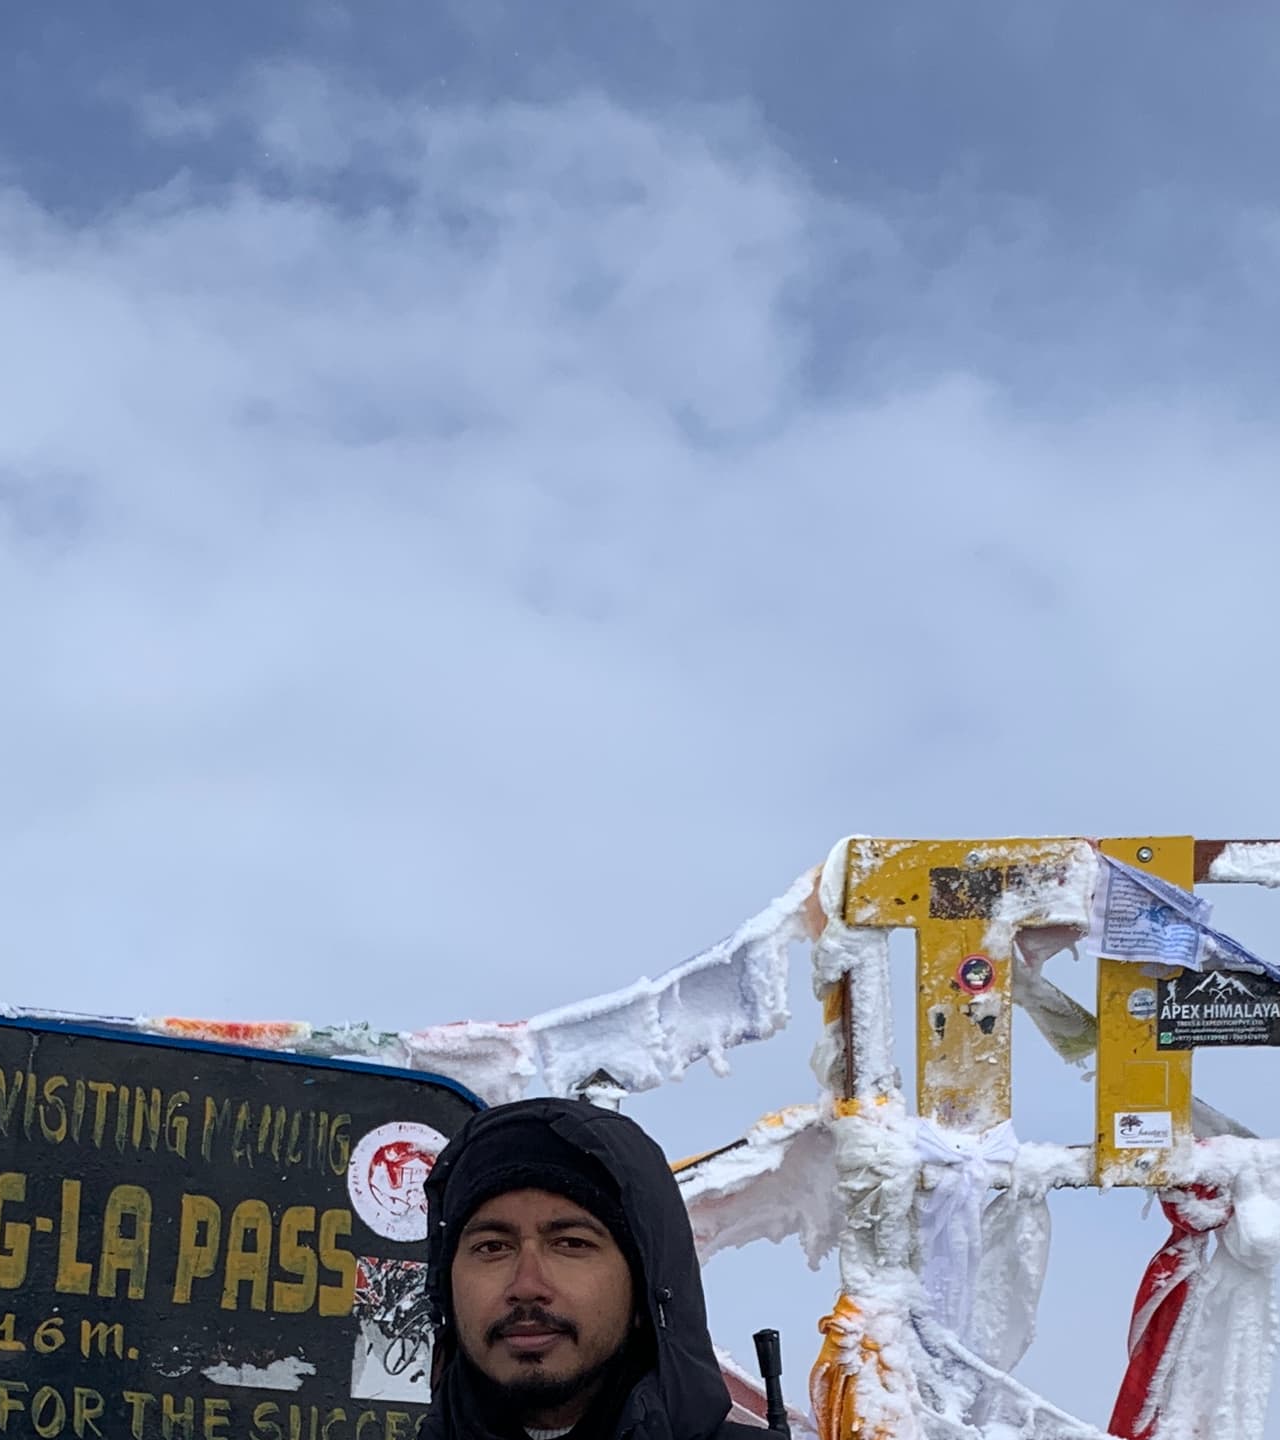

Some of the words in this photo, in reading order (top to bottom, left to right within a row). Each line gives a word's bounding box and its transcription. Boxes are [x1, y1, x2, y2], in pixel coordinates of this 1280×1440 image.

[1160, 1003, 1200, 1020] APEX
[1204, 1003, 1280, 1019] HIMALAYA
[172, 1193, 359, 1318] PASS
